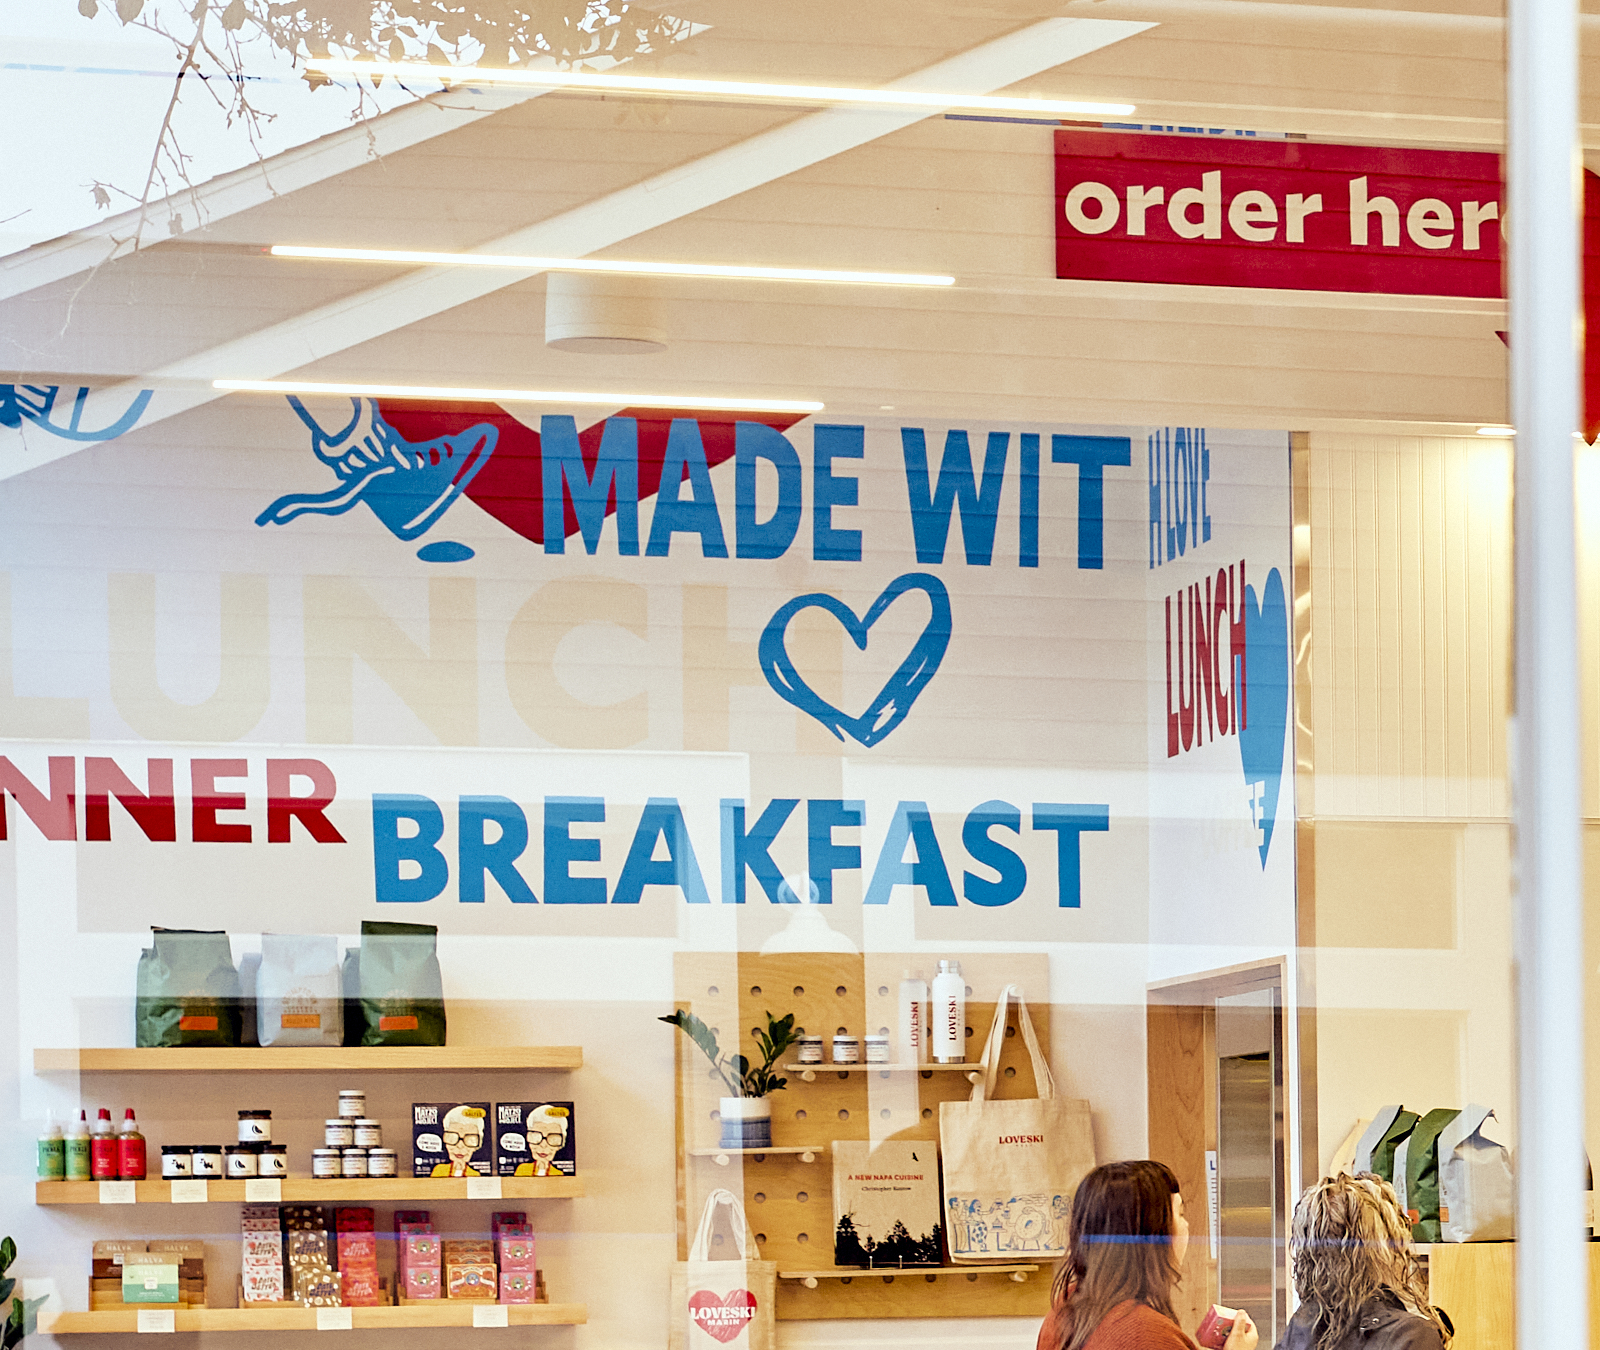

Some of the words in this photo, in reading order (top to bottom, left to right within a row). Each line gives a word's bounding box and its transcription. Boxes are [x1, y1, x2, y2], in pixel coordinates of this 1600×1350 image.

[1064, 170, 1322, 244] order
[1349, 175, 1509, 250] her
[539, 413, 865, 562] MADE
[1165, 559, 1247, 758] LUNCH
[372, 792, 1110, 908] BREAKFAST
[910, 1001, 919, 1047] LOVESKI
[948, 995, 957, 1041] LOVESKI
[999, 1135, 1044, 1144] LOVESKI
[690, 1306, 756, 1320] LOVESKI
